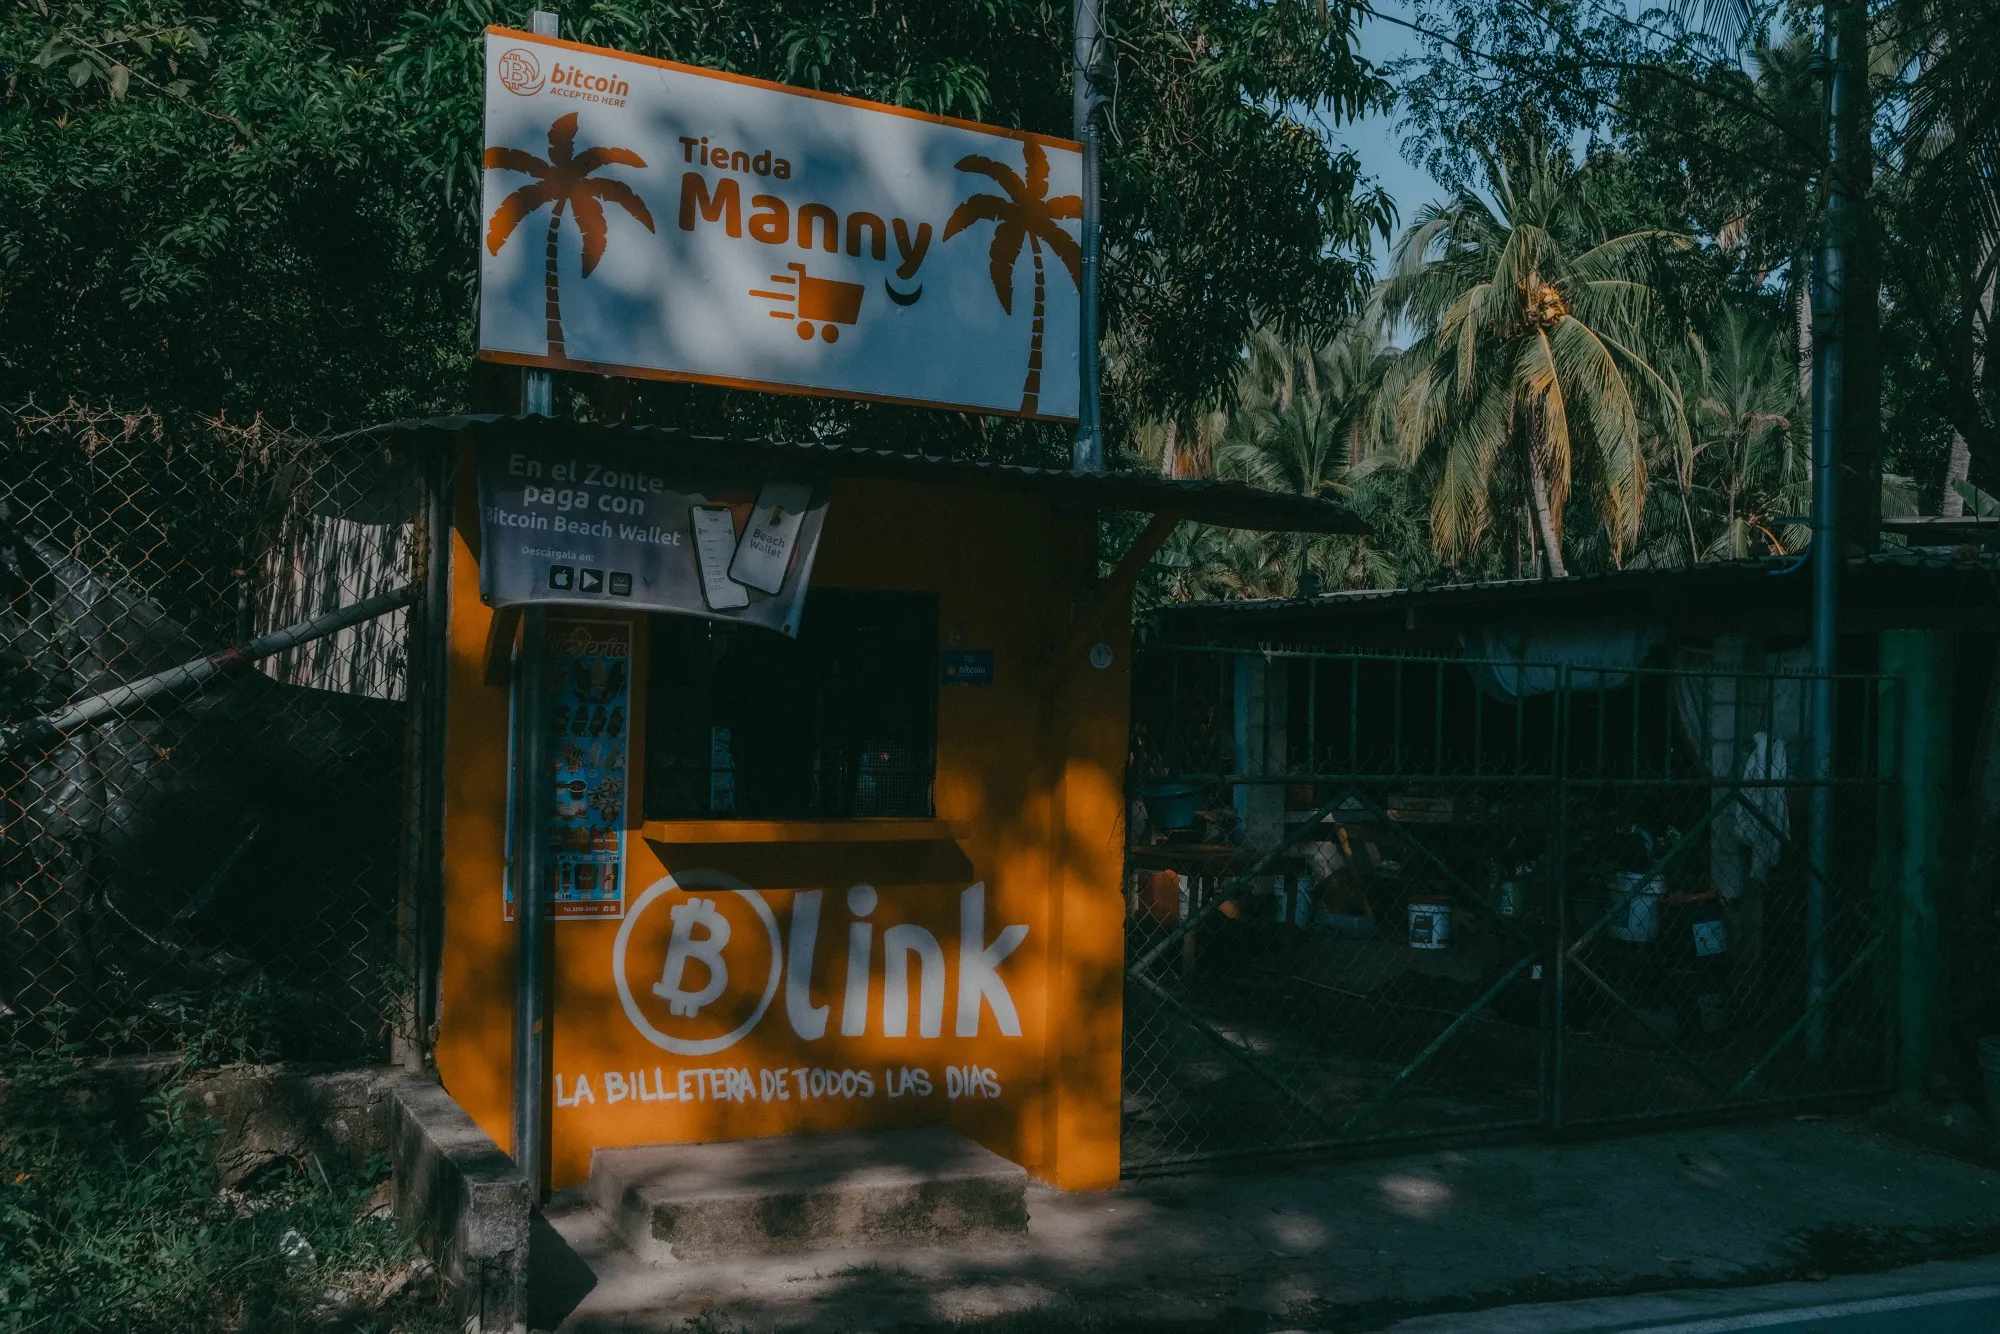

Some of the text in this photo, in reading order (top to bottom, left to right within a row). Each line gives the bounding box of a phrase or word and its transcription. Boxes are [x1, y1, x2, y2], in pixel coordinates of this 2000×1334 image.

[551, 63, 629, 96] bitcoin
[550, 87, 627, 107] ACCEPTED HERE
[679, 136, 791, 180] Tienda
[679, 172, 933, 280] Manny
[509, 452, 664, 494] En el Zonte
[523, 485, 645, 516] paga con
[486, 506, 681, 546] Bitcoin Beach Wallet
[753, 528, 785, 548] Beach
[521, 546, 594, 562] Descárgala en:
[750, 539, 782, 558] Wallet
[959, 665, 986, 674] bitcoin
[556, 1064, 1001, 1107] LA BILLETERA DE TODOS LAS DIAS
